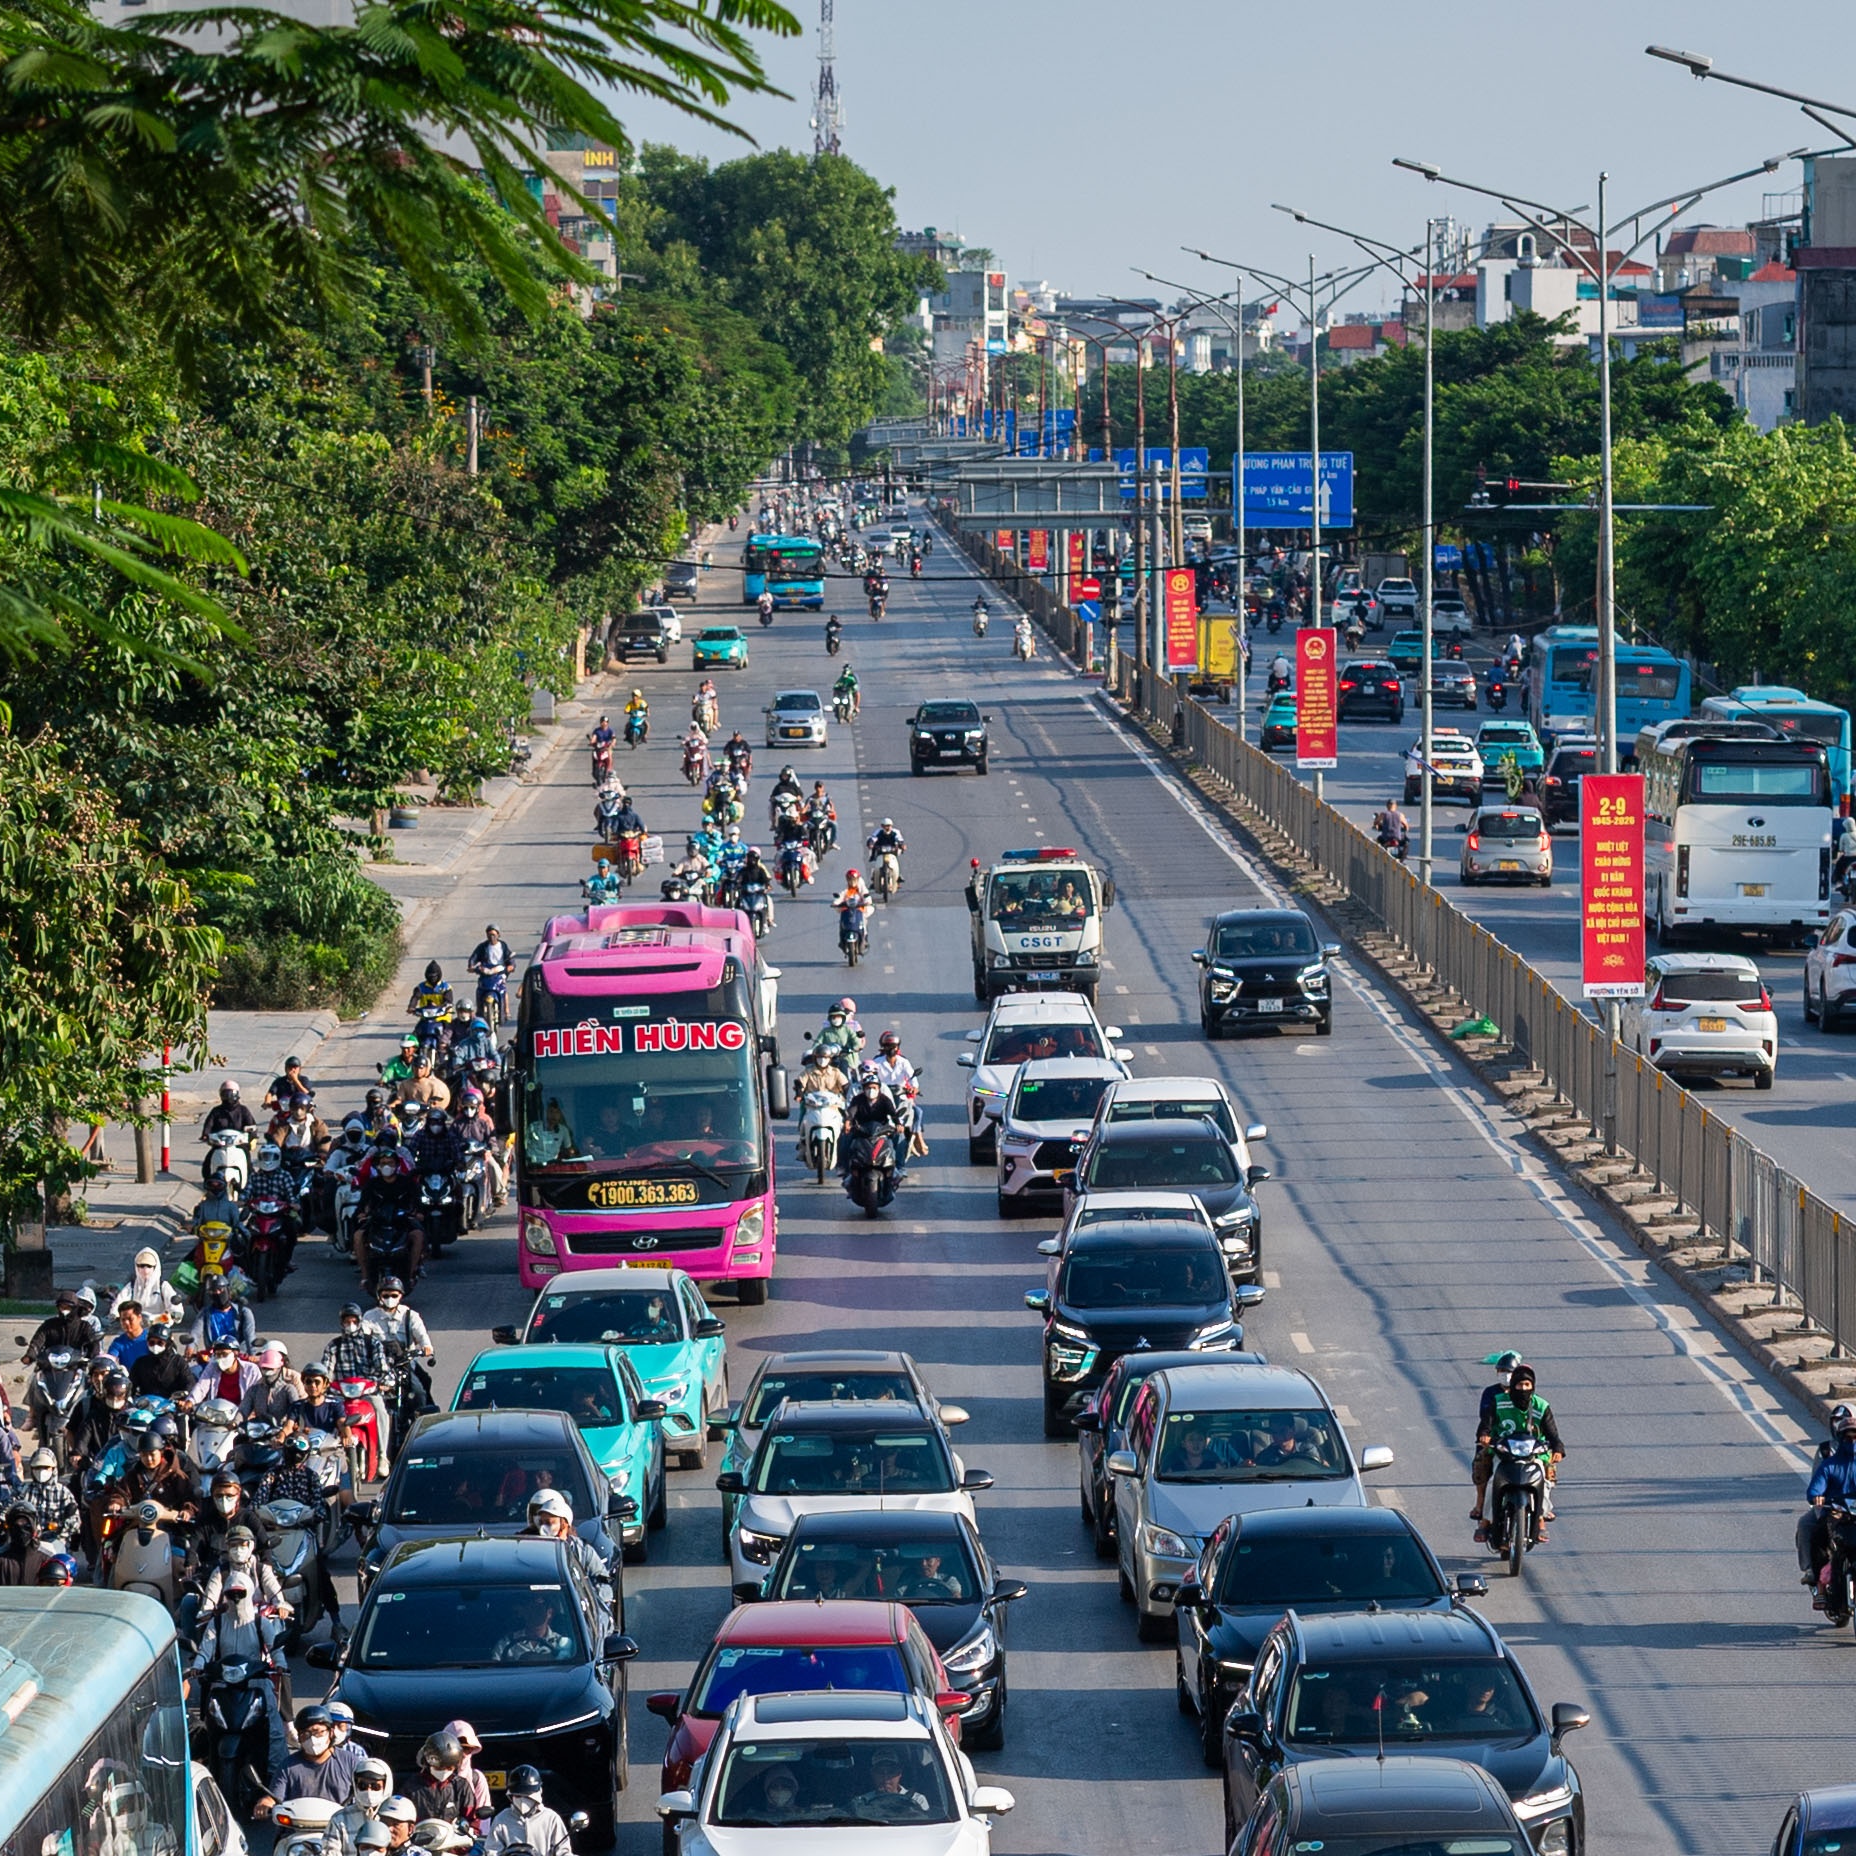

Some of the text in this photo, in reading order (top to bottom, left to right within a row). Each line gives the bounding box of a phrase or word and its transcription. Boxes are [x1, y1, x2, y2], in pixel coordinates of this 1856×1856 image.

[1599, 797, 1626, 816] 2-9
[1020, 936, 1063, 948] CSGT
[534, 1017, 745, 1057] HIỀN HÙNG
[599, 1184, 696, 1206] 1900.363.363
